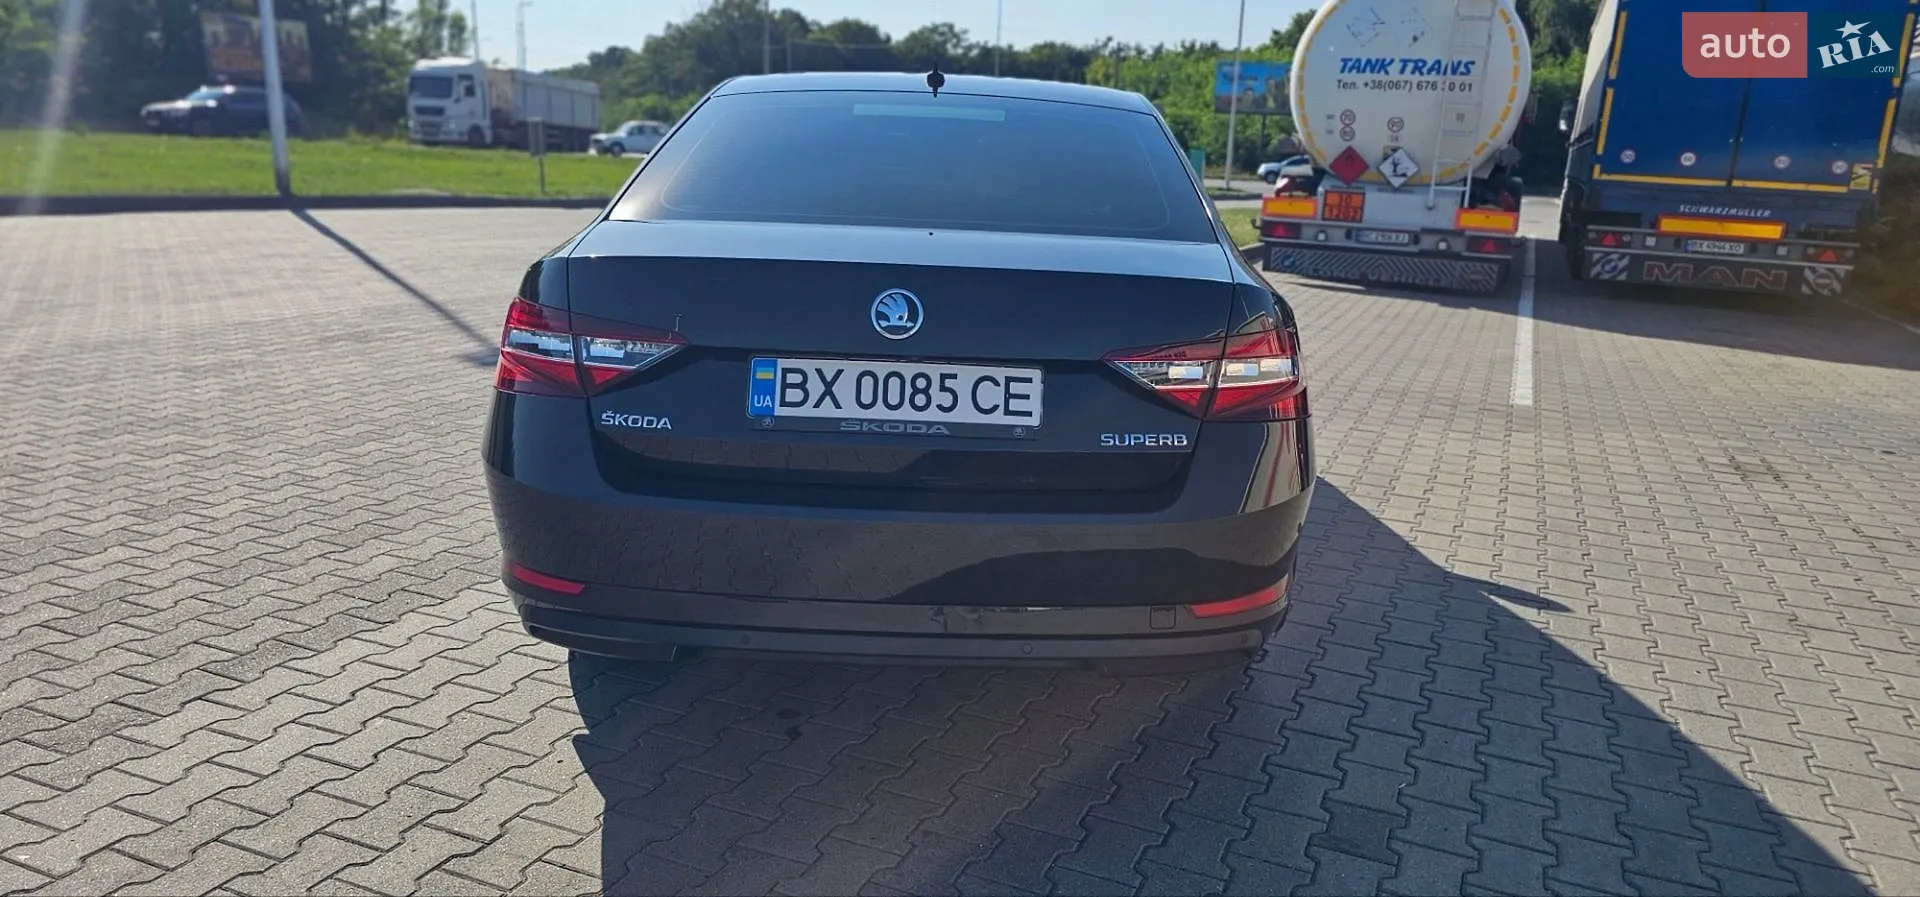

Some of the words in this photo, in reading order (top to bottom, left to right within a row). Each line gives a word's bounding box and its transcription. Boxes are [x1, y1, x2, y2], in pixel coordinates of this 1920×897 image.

[1340, 58, 1395, 75] TANK
[1398, 58, 1475, 76] TRANS
[1363, 80, 1413, 92] +38(067)
[1416, 81, 1439, 91] 676
[1458, 82, 1473, 92] 01
[1642, 261, 1788, 290] MAN
[754, 394, 773, 408] UA
[779, 367, 845, 410] BX
[855, 370, 959, 413] 0085
[971, 375, 1033, 418] CE
[600, 410, 672, 430] ŠKODA
[1100, 433, 1188, 446] SUPERB
